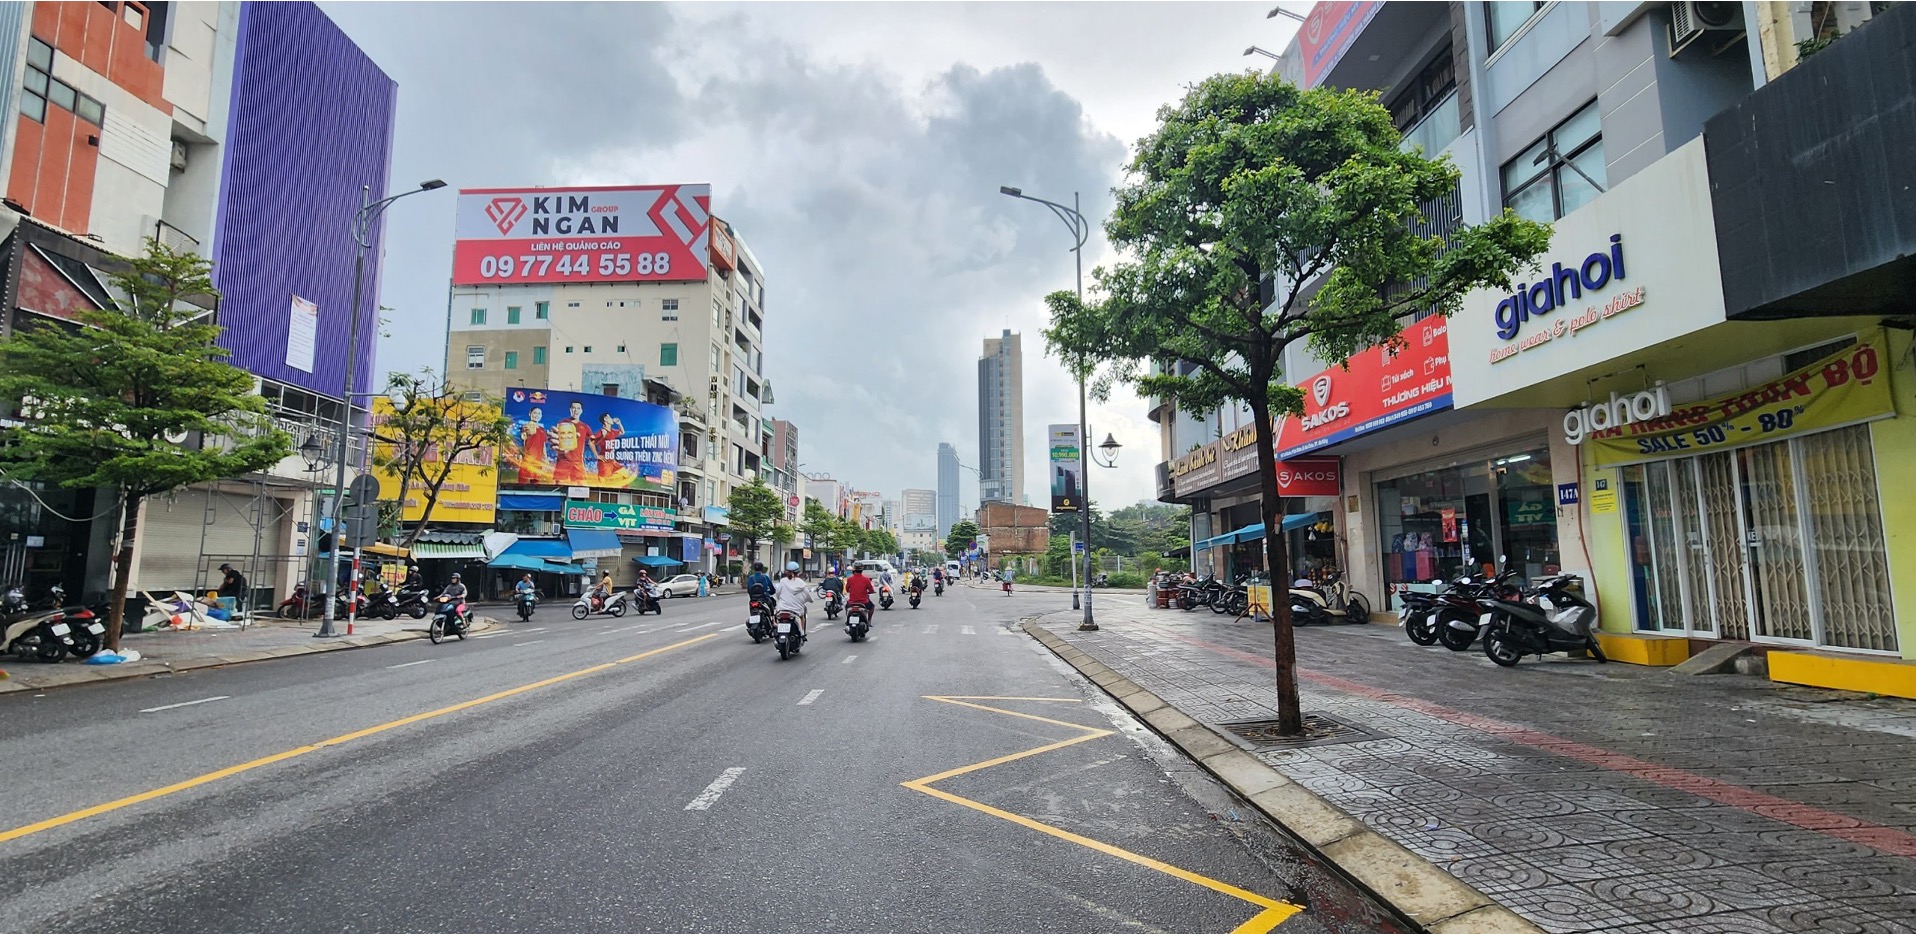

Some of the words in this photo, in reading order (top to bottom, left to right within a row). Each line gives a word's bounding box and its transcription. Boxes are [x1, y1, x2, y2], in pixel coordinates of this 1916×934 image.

[533, 196, 588, 214] KIM
[591, 205, 619, 213] GROUP
[532, 216, 619, 235] NGAN
[531, 241, 551, 251] LIÊN
[552, 241, 564, 252] HỆ
[565, 240, 599, 251] QUẢNG
[599, 240, 621, 250] CÁO
[1495, 233, 1626, 340] giahoi
[1433, 326, 1446, 337] Balo
[1489, 344, 1517, 364] home
[1519, 329, 1551, 351] wear
[1553, 319, 1565, 337] &
[1570, 306, 1599, 336] polo
[1601, 287, 1645, 319] shirt
[1822, 343, 1878, 388] BỘ
[1382, 386, 1420, 408] THƯƠNG
[1421, 378, 1443, 394] HIỆU
[1301, 401, 1349, 432] SAKOS
[1563, 380, 1672, 445] giahoi
[1637, 433, 1690, 454] SALE
[1692, 421, 1735, 446] 50%
[1757, 405, 1804, 433] 80%
[605, 439, 620, 450] RED
[621, 436, 640, 449] BULL
[616, 451, 634, 461] SUNG
[1280, 471, 1335, 480] SAKOS
[1560, 488, 1578, 500] 147A
[568, 506, 602, 523] CHÁO
[618, 505, 636, 515] GÀ
[617, 517, 637, 528] VỊT
